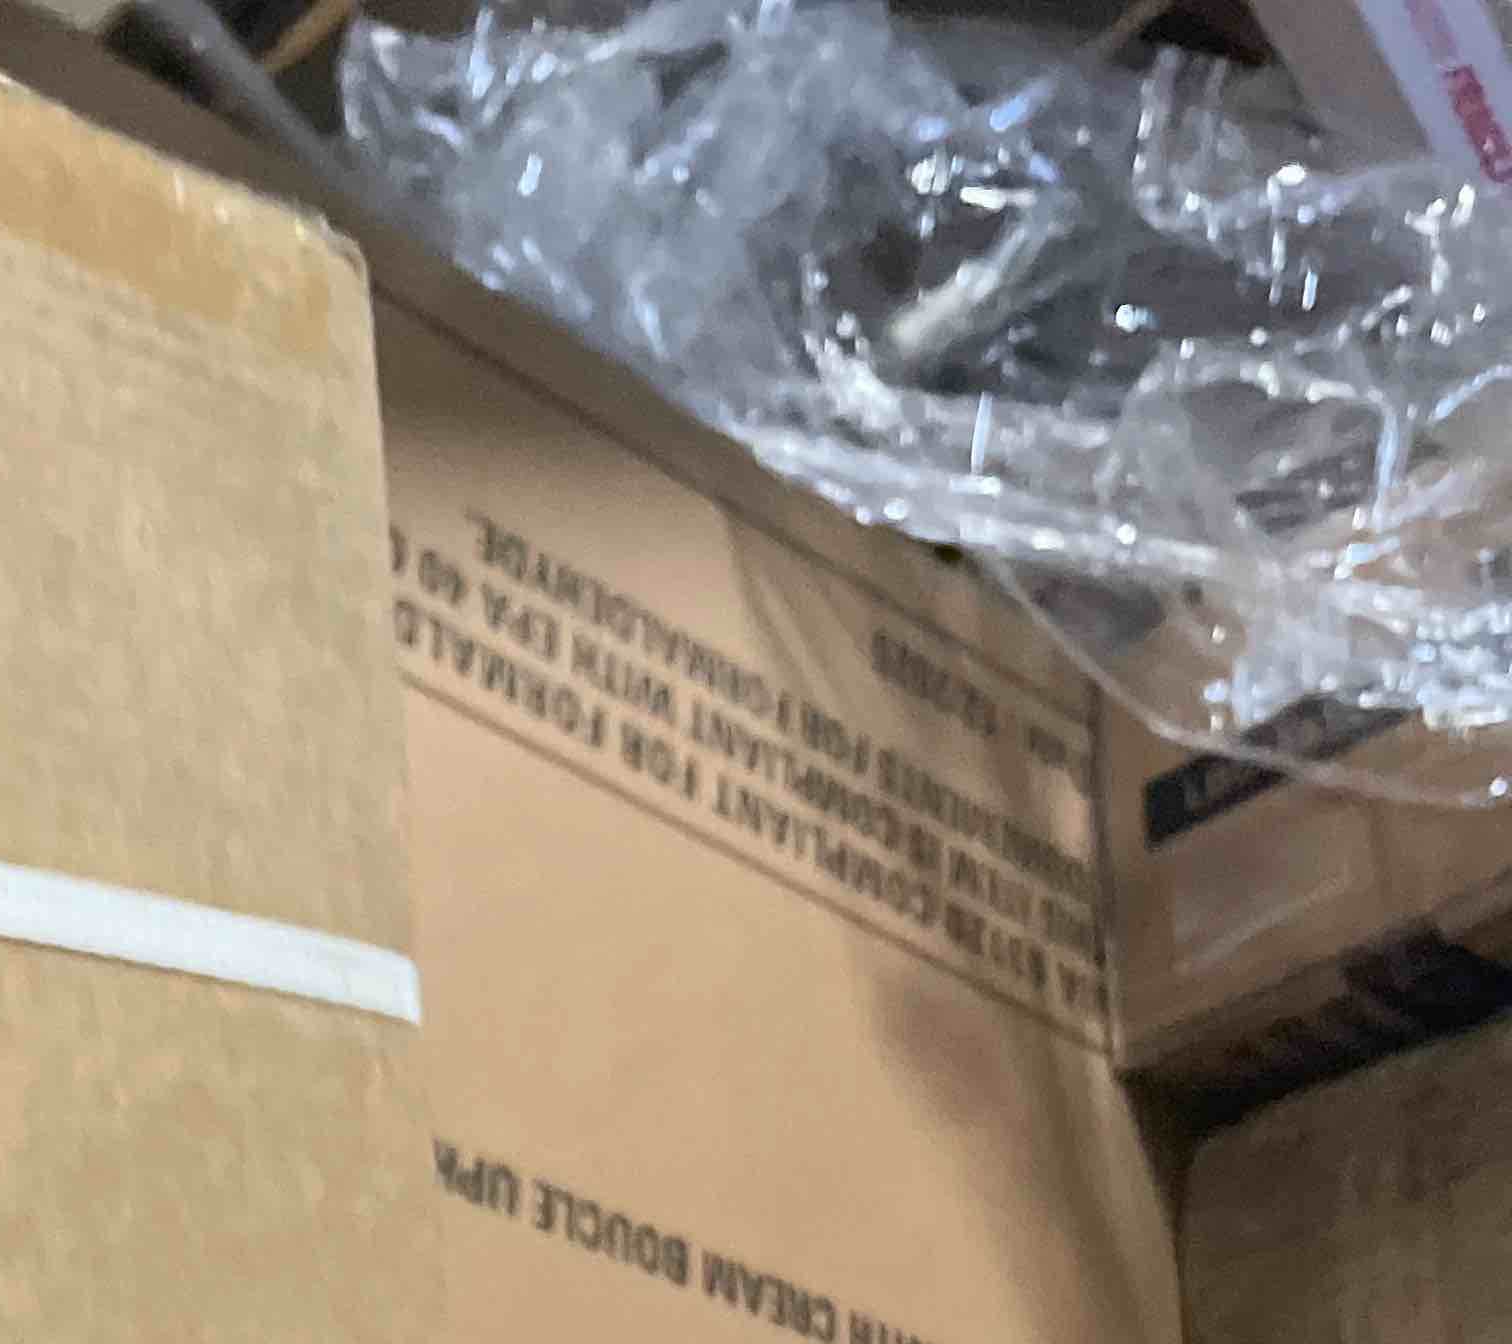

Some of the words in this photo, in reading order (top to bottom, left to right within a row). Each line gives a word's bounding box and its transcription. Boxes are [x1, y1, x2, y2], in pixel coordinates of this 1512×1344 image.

[393, 600, 604, 748] FORMALD
[531, 1178, 690, 1290] BOUCLE
[701, 1247, 837, 1344] CREAM
